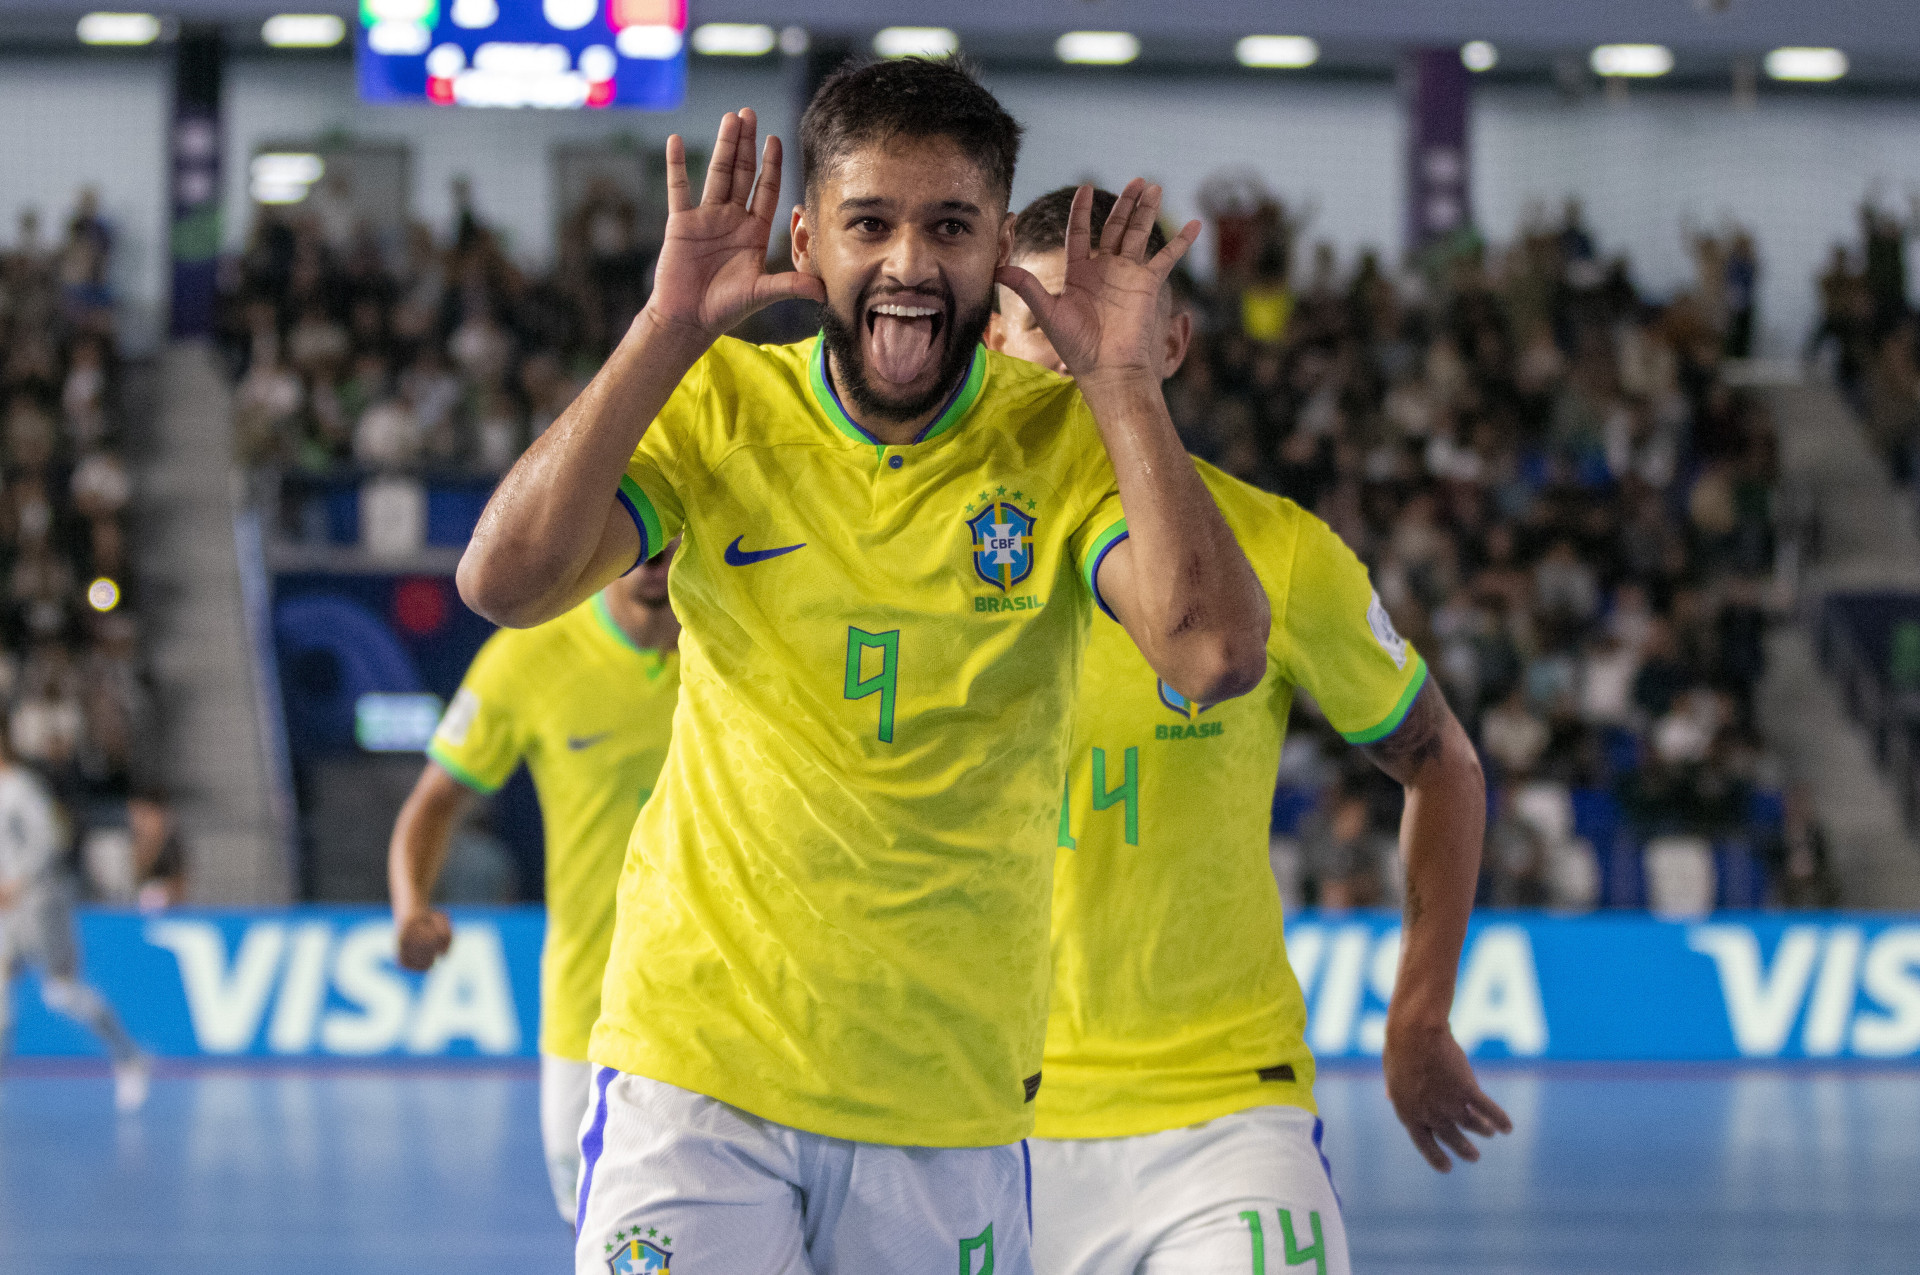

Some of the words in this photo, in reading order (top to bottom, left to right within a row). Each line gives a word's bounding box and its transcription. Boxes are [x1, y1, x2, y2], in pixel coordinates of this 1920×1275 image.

[990, 538, 1016, 550] CBF
[974, 594, 1047, 613] BRASIL
[844, 625, 900, 744] 9
[1155, 721, 1225, 740] BRASIL
[144, 919, 523, 1056] VISA
[1238, 1208, 1327, 1275] 14
